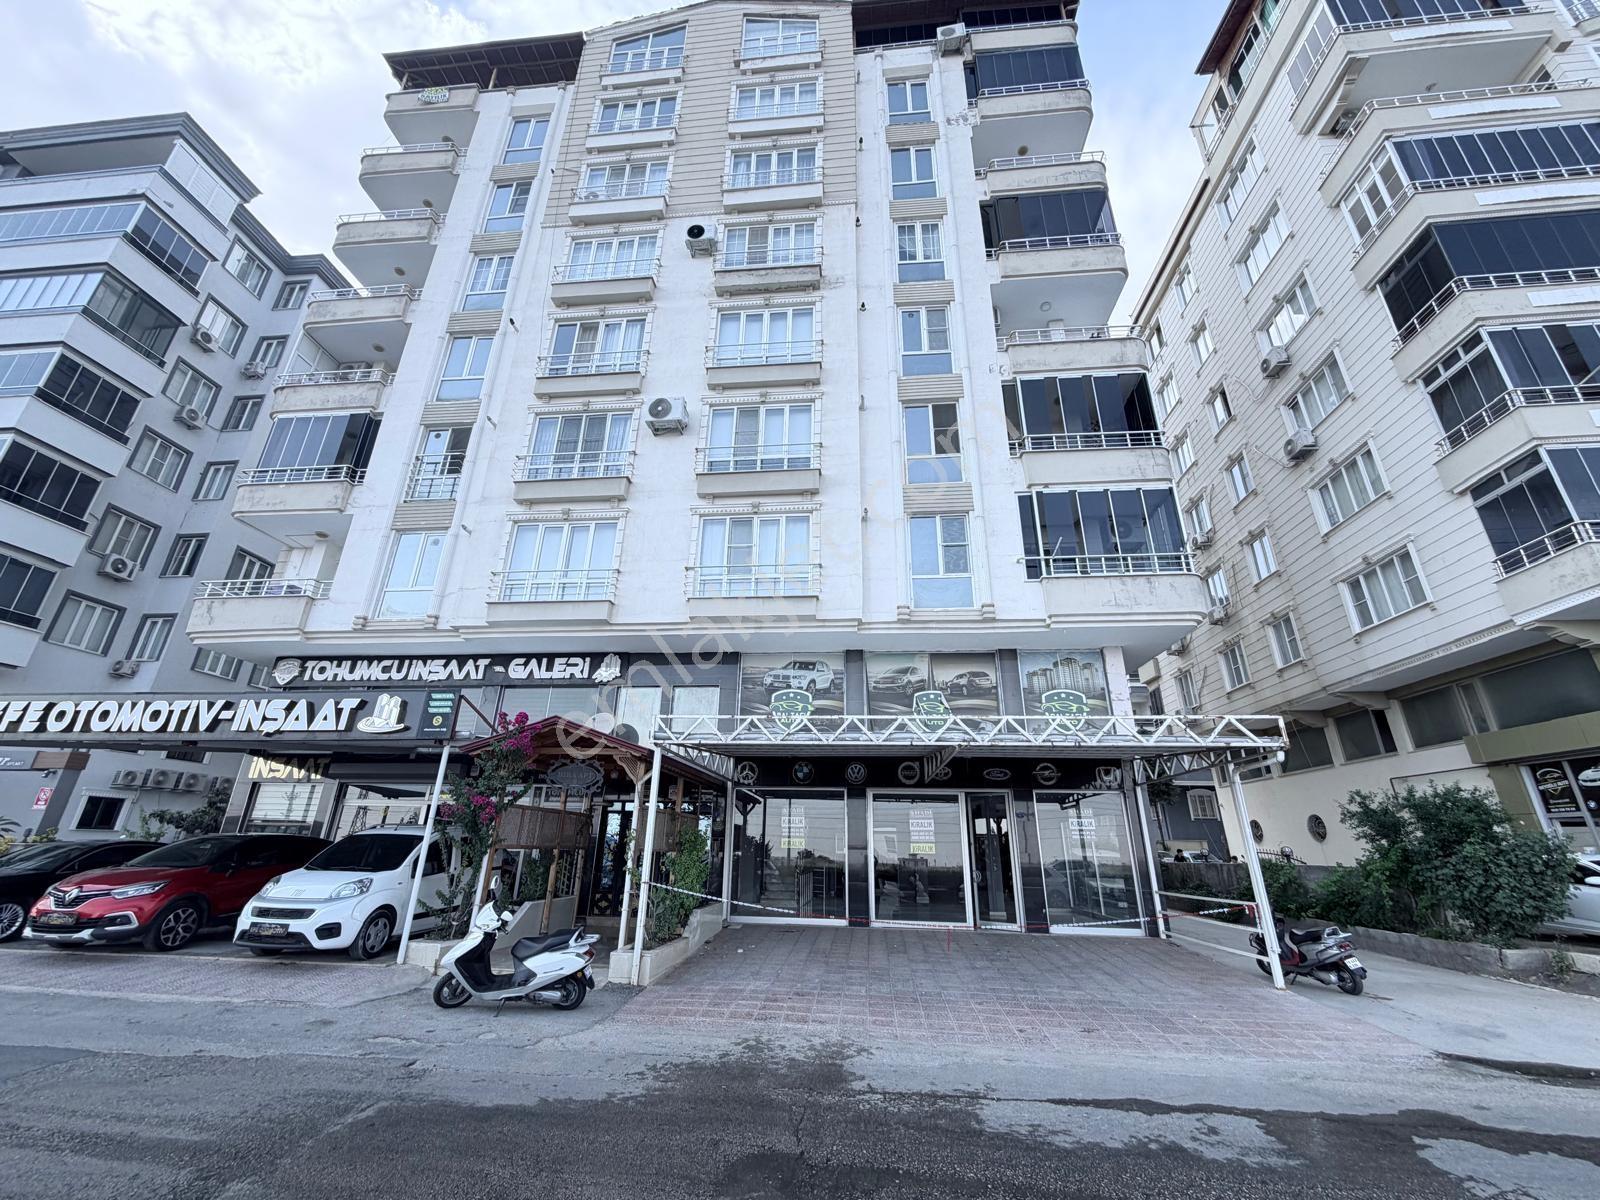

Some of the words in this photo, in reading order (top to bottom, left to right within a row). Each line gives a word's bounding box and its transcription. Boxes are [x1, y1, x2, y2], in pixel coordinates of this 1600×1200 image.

[303, 661, 408, 681] TOHUMCU
[409, 659, 491, 682] İNŞAAT
[508, 658, 590, 679] GALERİ
[0, 700, 50, 732] FE
